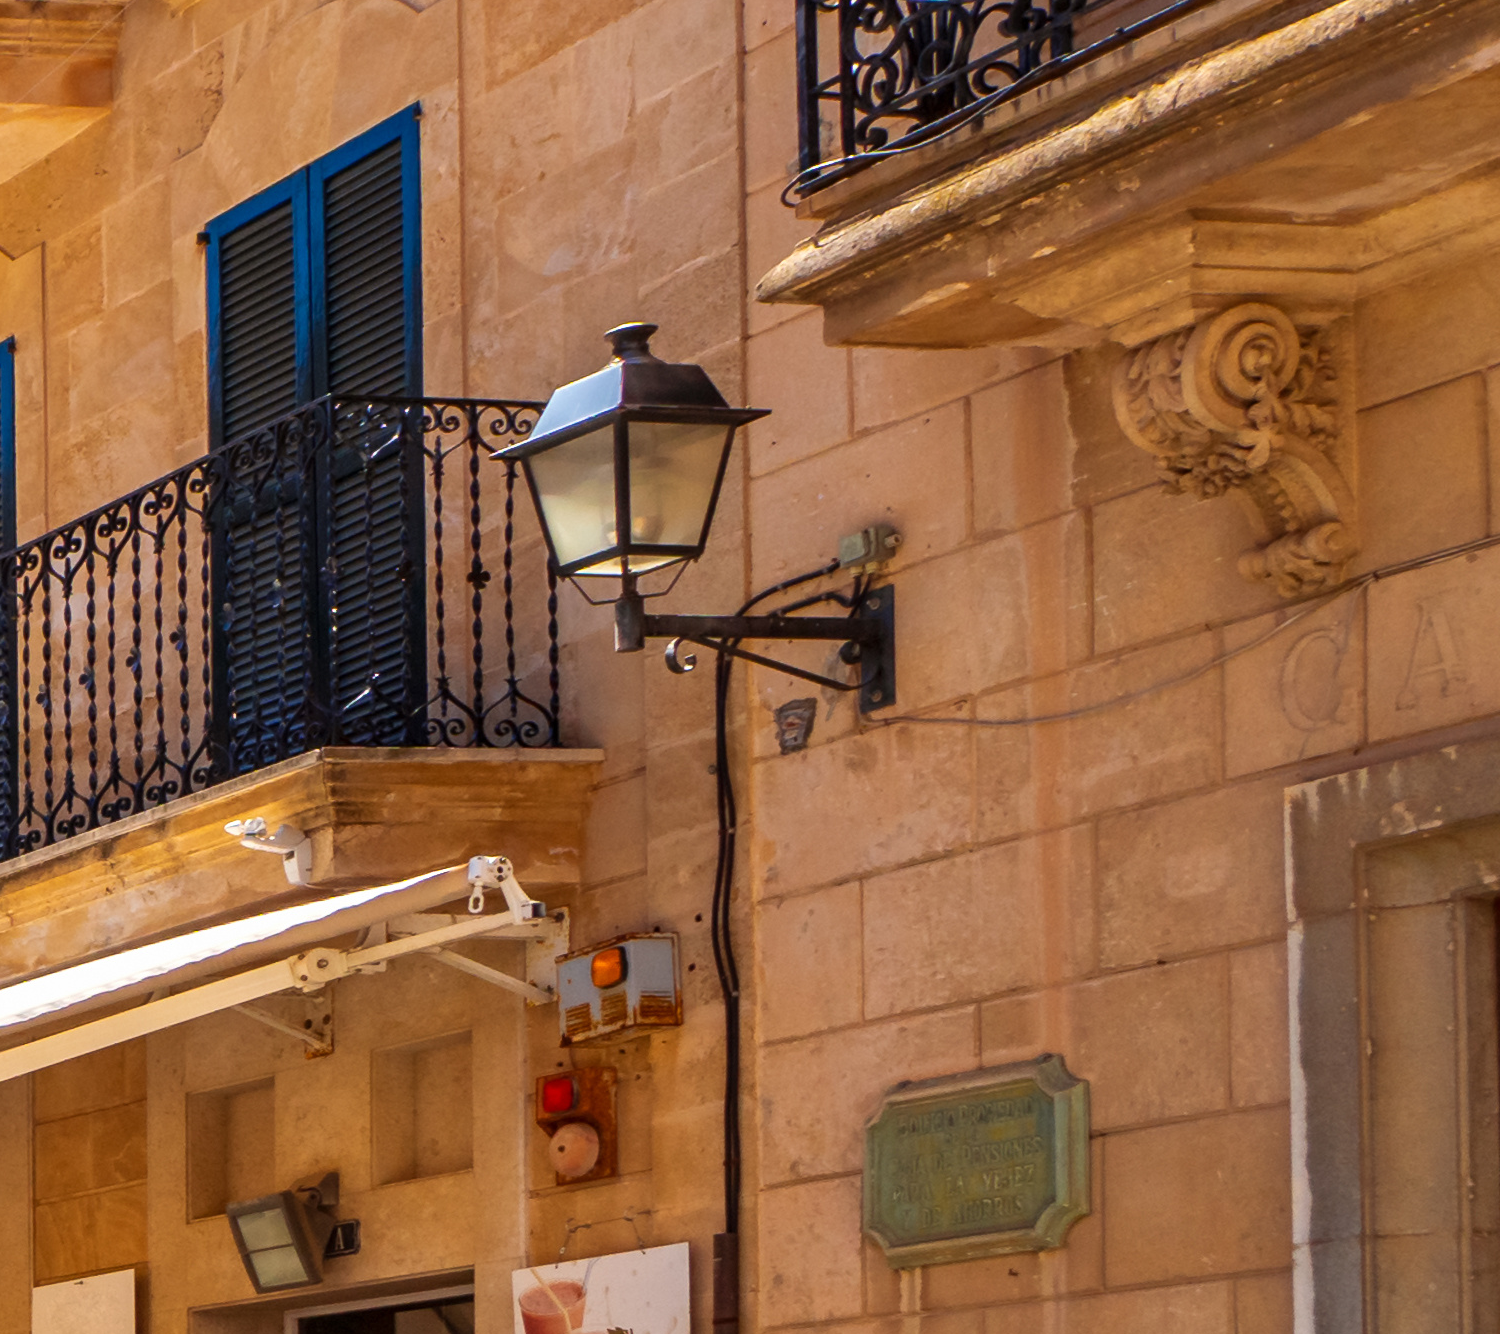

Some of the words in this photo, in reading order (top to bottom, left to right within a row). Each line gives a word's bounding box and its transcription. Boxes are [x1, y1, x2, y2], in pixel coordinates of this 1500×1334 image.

[963, 1136, 1043, 1165] PENSIONES
[983, 1164, 1035, 1192] VEJEZ
[922, 1206, 940, 1229] DE
[952, 1195, 1023, 1224] AHORROS
